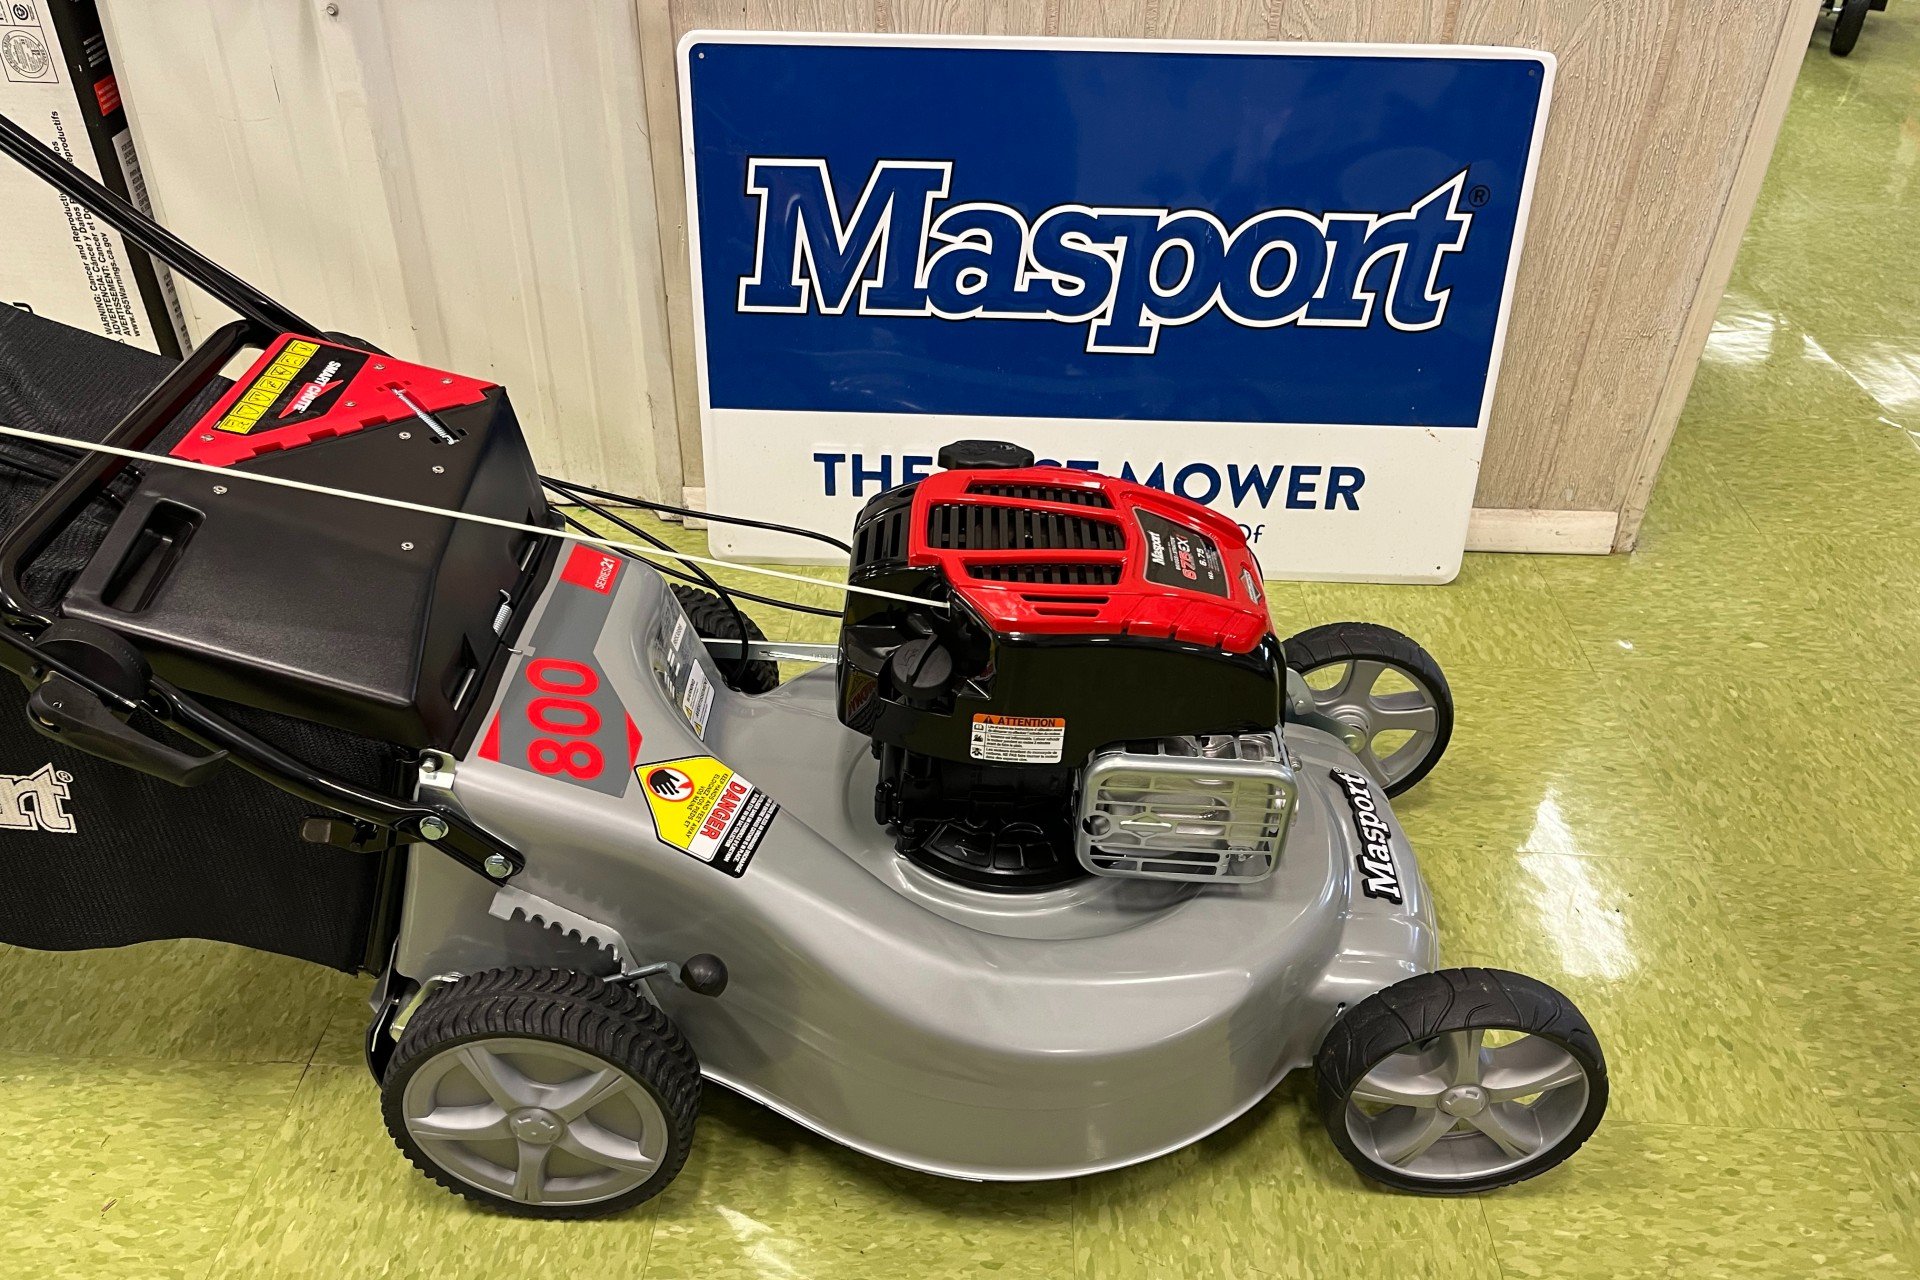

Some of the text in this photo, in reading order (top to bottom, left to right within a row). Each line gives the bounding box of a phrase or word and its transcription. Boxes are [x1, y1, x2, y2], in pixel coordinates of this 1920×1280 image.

[51, 111, 74, 165] eproductifs
[86, 221, 95, 231] et
[91, 232, 106, 263] Cancer
[75, 244, 87, 261] and
[735, 155, 1474, 356] Masport
[83, 262, 98, 292] Cancer
[100, 232, 141, 337] www.P65Warnings.ca.gov
[102, 265, 132, 336] AVERTISSEMENT:
[94, 294, 113, 335] WARNING:
[97, 275, 121, 335] ADVERTENCIA:
[293, 360, 342, 413] SMART CHUTE
[813, 452, 1366, 511] THE MOWER
[1147, 530, 1165, 566] Masport
[1196, 547, 1207, 567] 6.75
[525, 657, 605, 781] 800
[997, 717, 1056, 727] ATTENTION
[700, 781, 747, 840] DANGER
[702, 800, 711, 811] AND
[685, 823, 696, 839] AWAY
[1335, 771, 1401, 902] Masport
